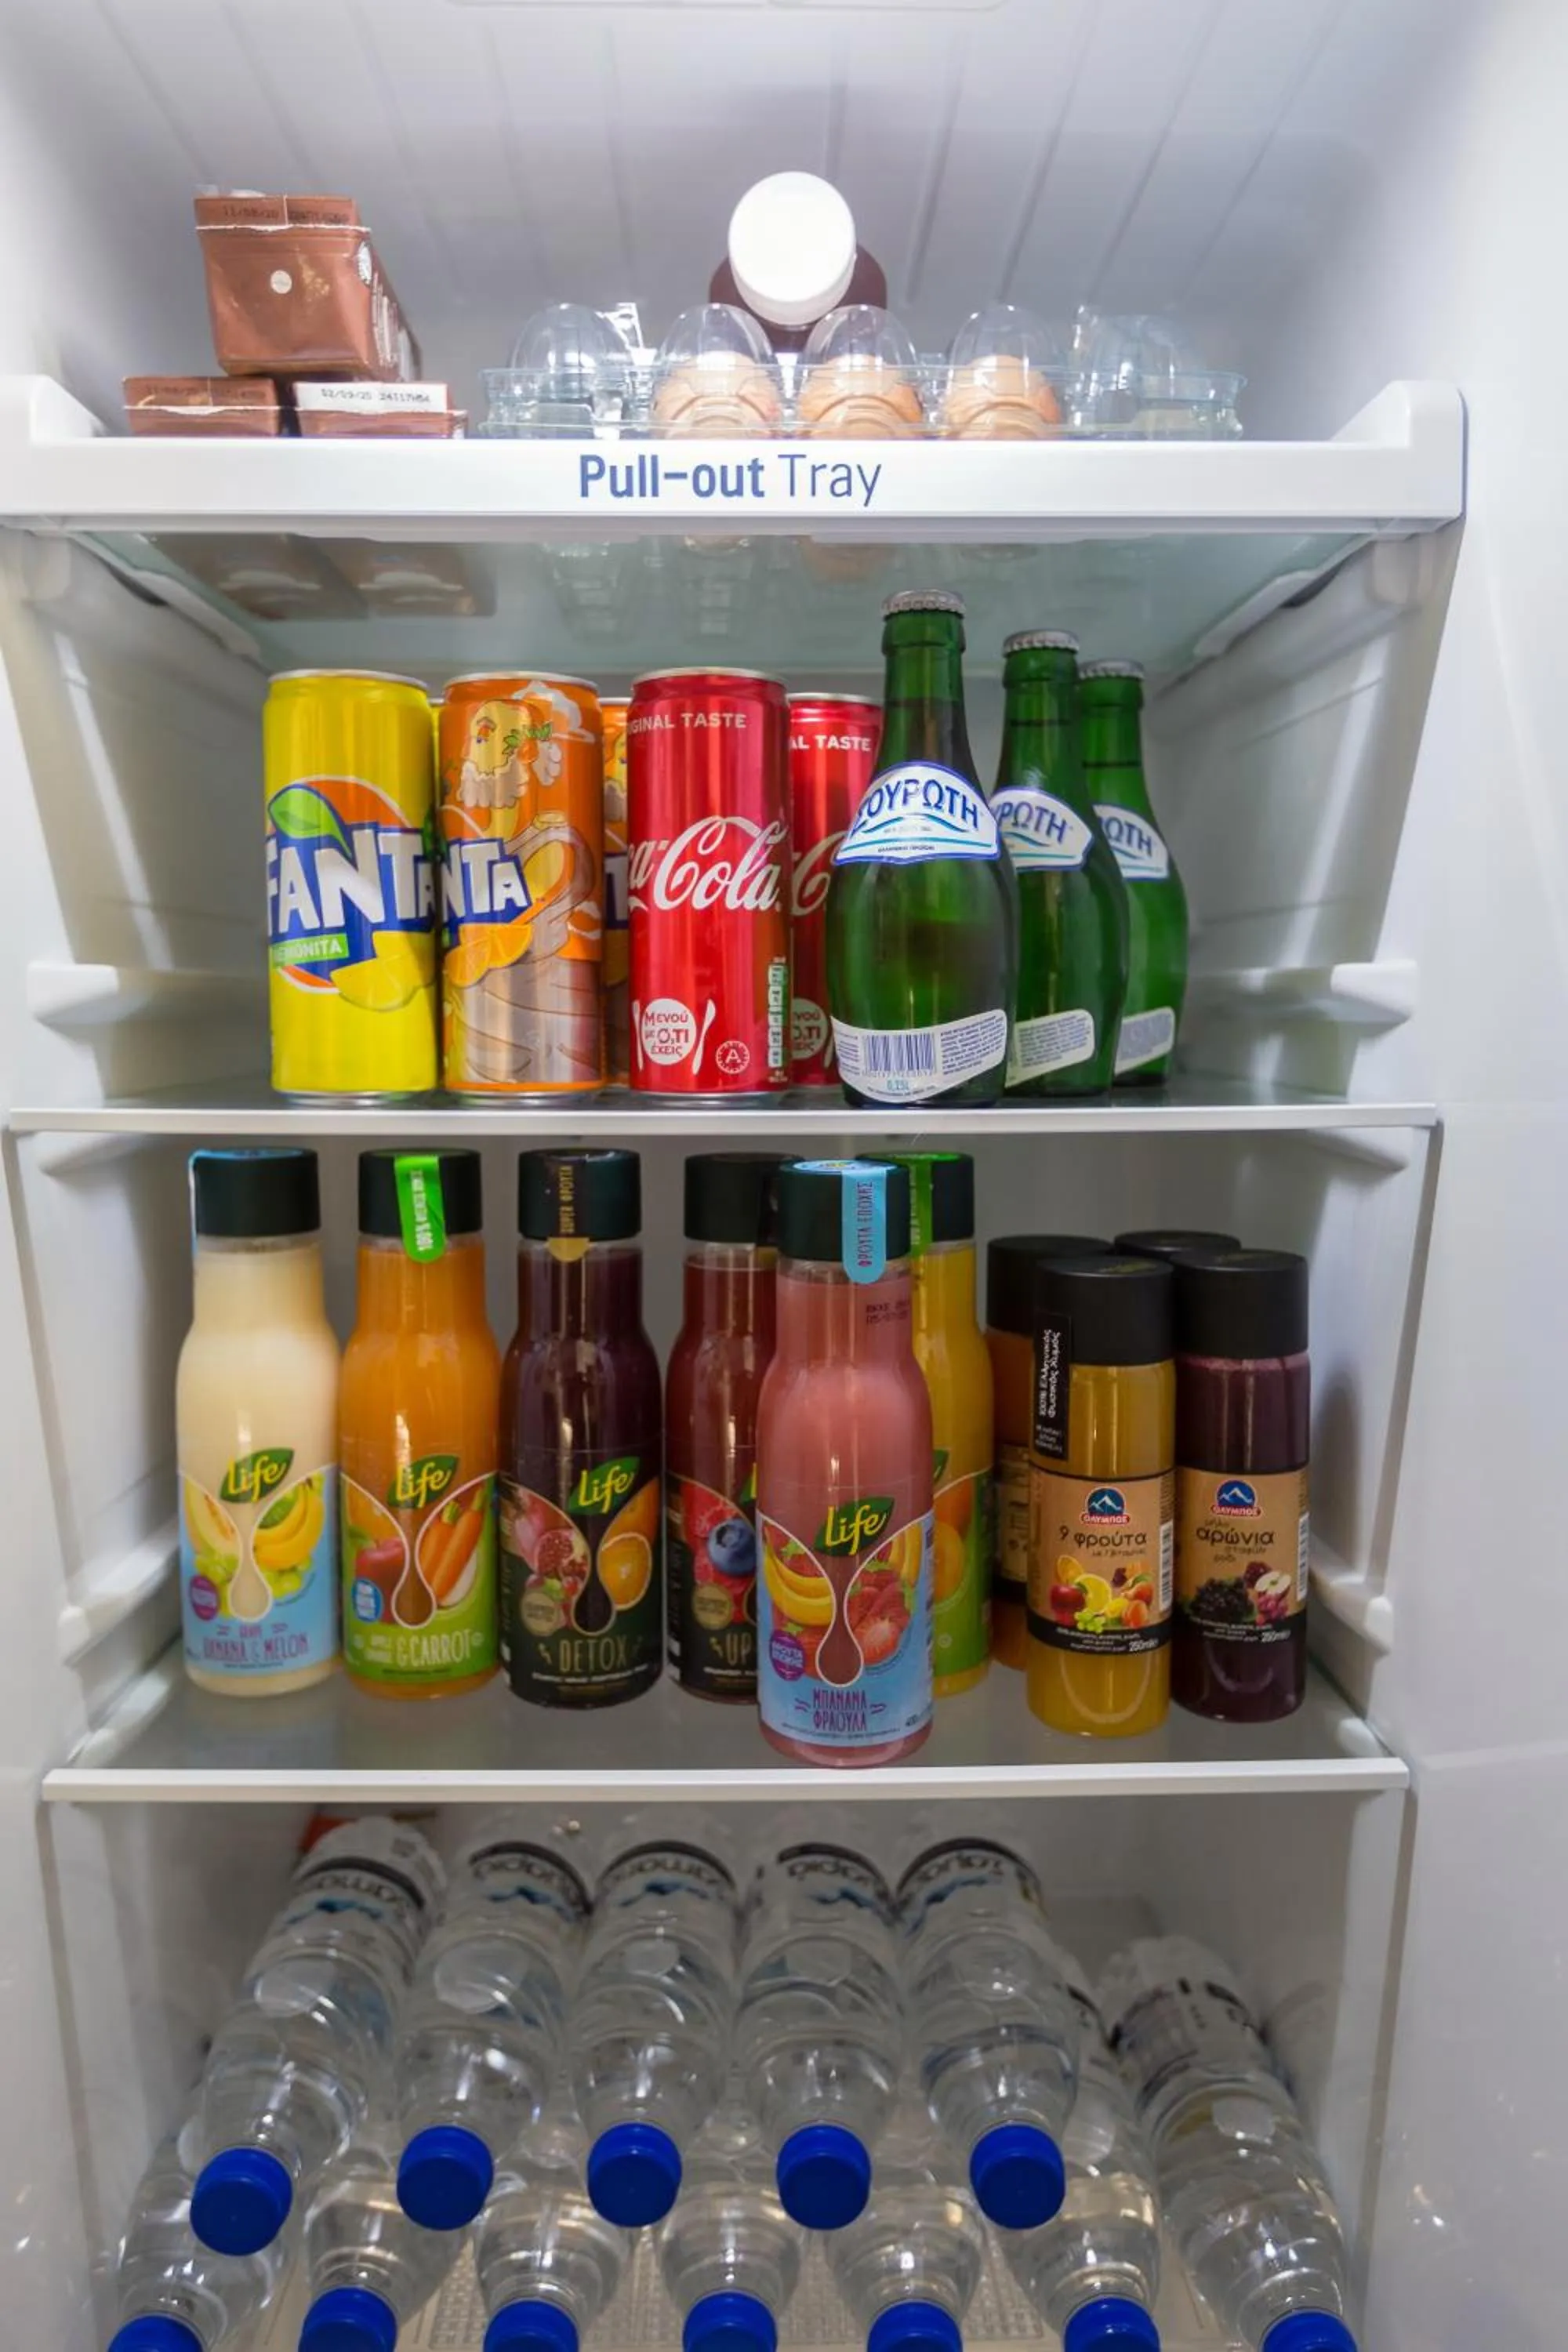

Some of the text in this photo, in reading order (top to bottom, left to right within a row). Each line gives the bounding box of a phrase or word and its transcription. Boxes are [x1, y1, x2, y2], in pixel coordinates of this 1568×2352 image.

[579, 454, 882, 507] Pull-out Tray
[681, 712, 747, 729] TASTE
[815, 734, 871, 752] TASTE
[857, 1227, 873, 1268] ΦΡΟΥΤΑ
[227, 1455, 287, 1504] Life
[395, 1461, 452, 1509] Life
[579, 1465, 635, 1514] Life
[825, 1504, 887, 1556] Life
[1074, 1530, 1147, 1549] φρούτα
[1196, 1527, 1275, 1547] αρώνια
[409, 1628, 473, 1667] CARROT
[559, 1635, 628, 1673] DETOX
[812, 1689, 868, 1711] ΜΠΑΝΑΝΑ
[813, 1710, 867, 1732] ΦΡΑΟΥΛΑ
